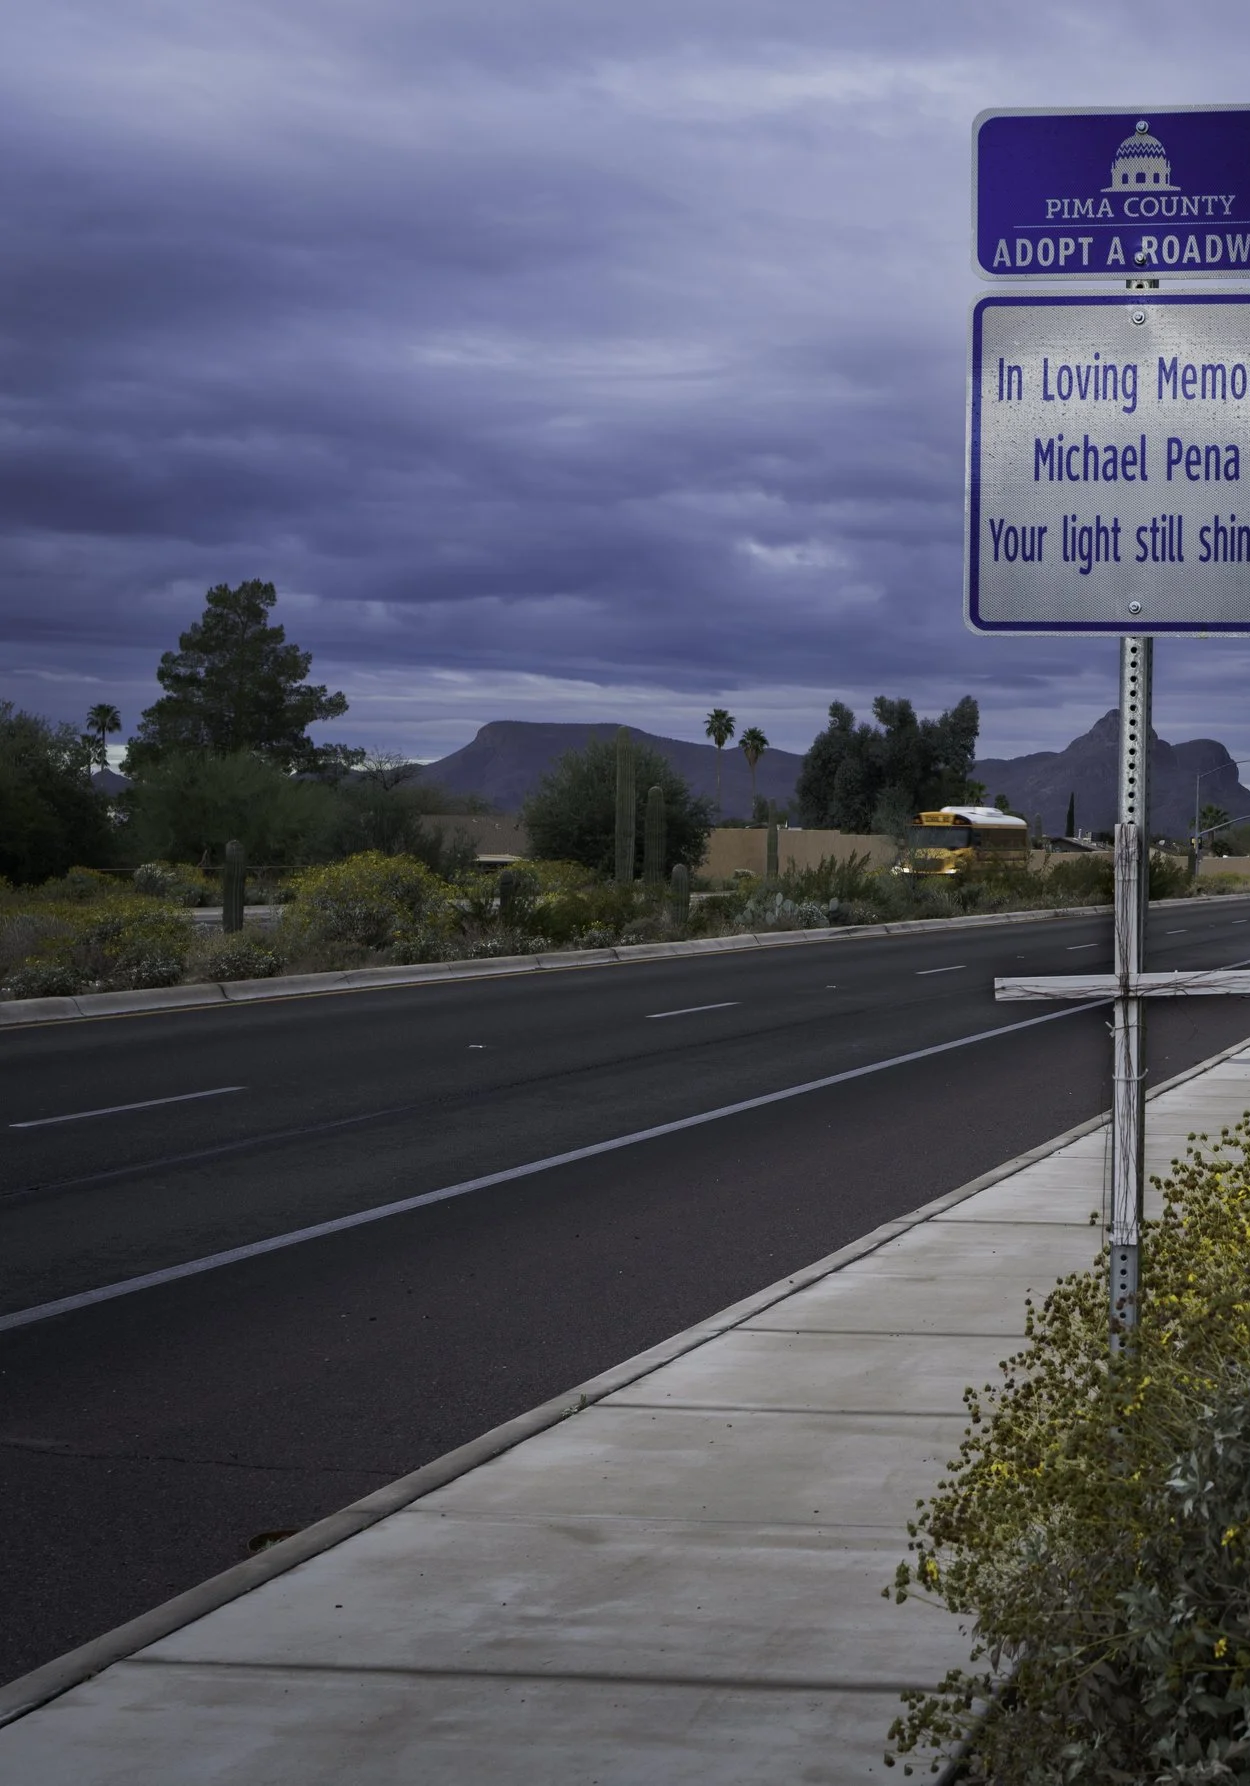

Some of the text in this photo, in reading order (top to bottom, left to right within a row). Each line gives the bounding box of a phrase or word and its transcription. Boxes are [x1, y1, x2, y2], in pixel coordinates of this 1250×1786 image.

[1046, 195, 1236, 218] PIMA COUNTY
[993, 237, 1093, 267] ADOPT
[1107, 236, 1126, 265] A
[999, 358, 1022, 402] In
[1043, 352, 1138, 413] Loving
[1034, 434, 1240, 482] Michael Pena
[989, 518, 1047, 562] Your
[1063, 515, 1121, 575] light
[1135, 515, 1184, 562] still
